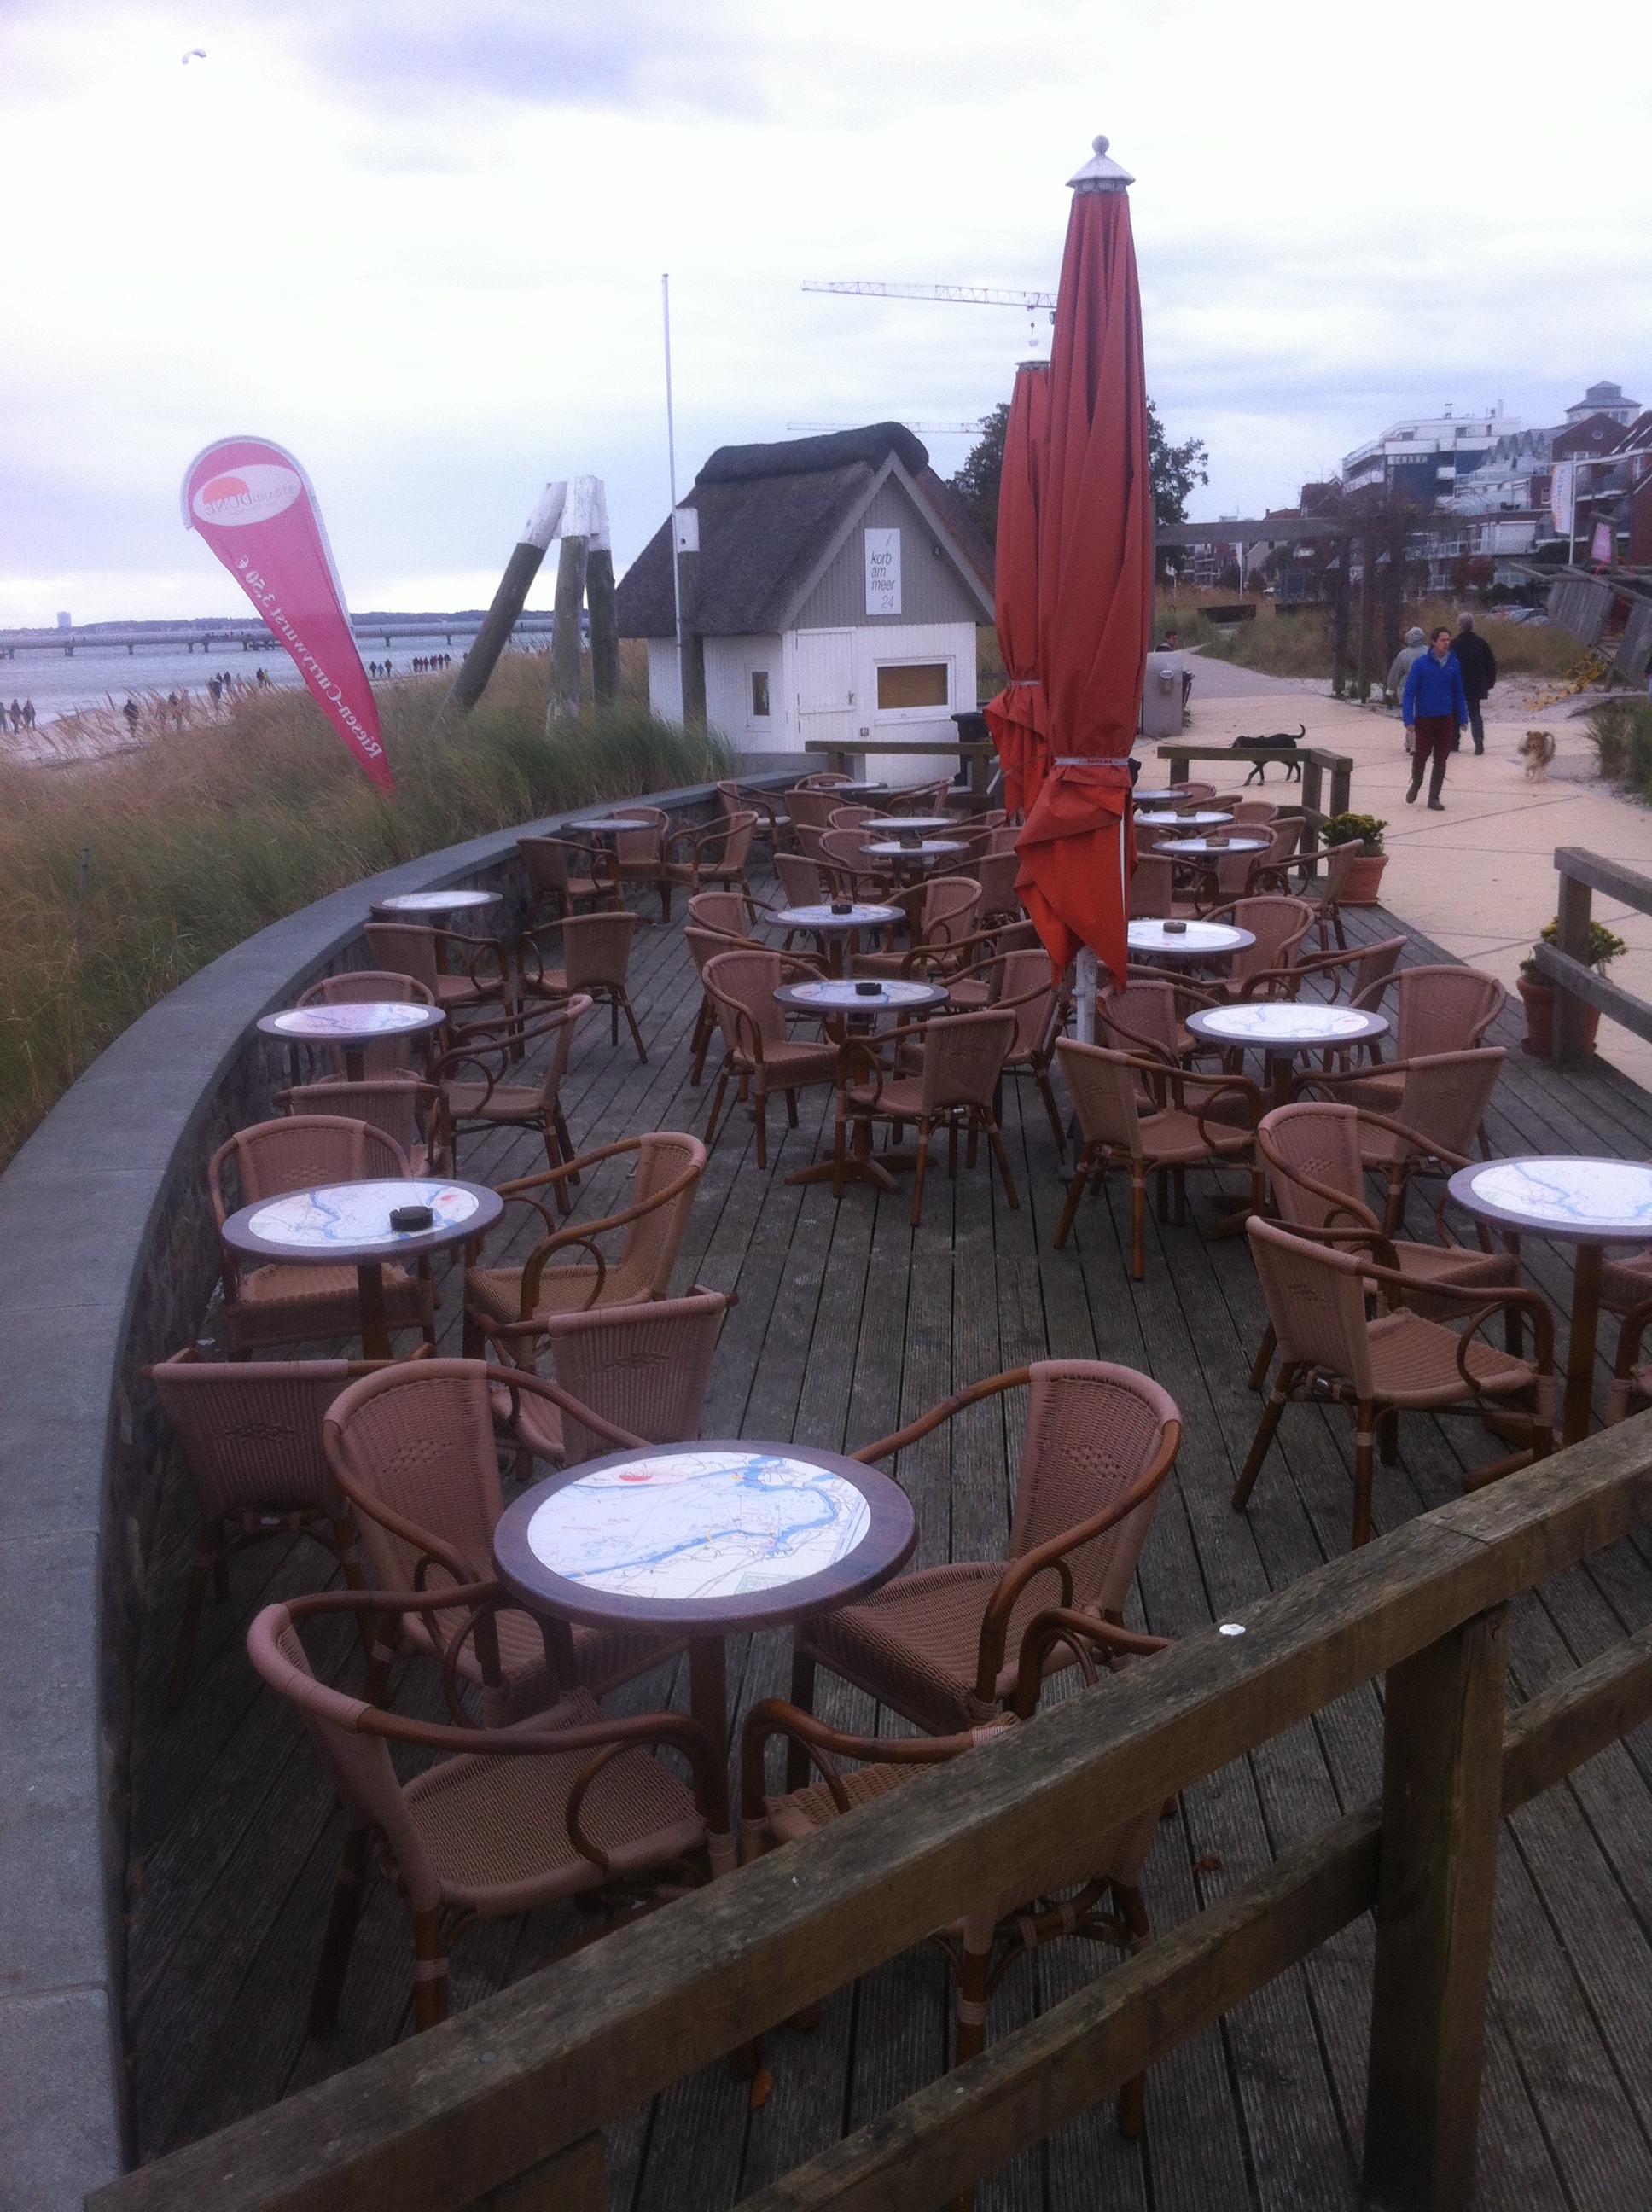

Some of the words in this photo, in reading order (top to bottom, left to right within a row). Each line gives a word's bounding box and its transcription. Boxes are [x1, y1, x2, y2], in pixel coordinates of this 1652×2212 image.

[870, 551, 892, 565] korb
[870, 568, 887, 579] am
[871, 579, 896, 591] meer
[881, 596, 894, 610] 24
